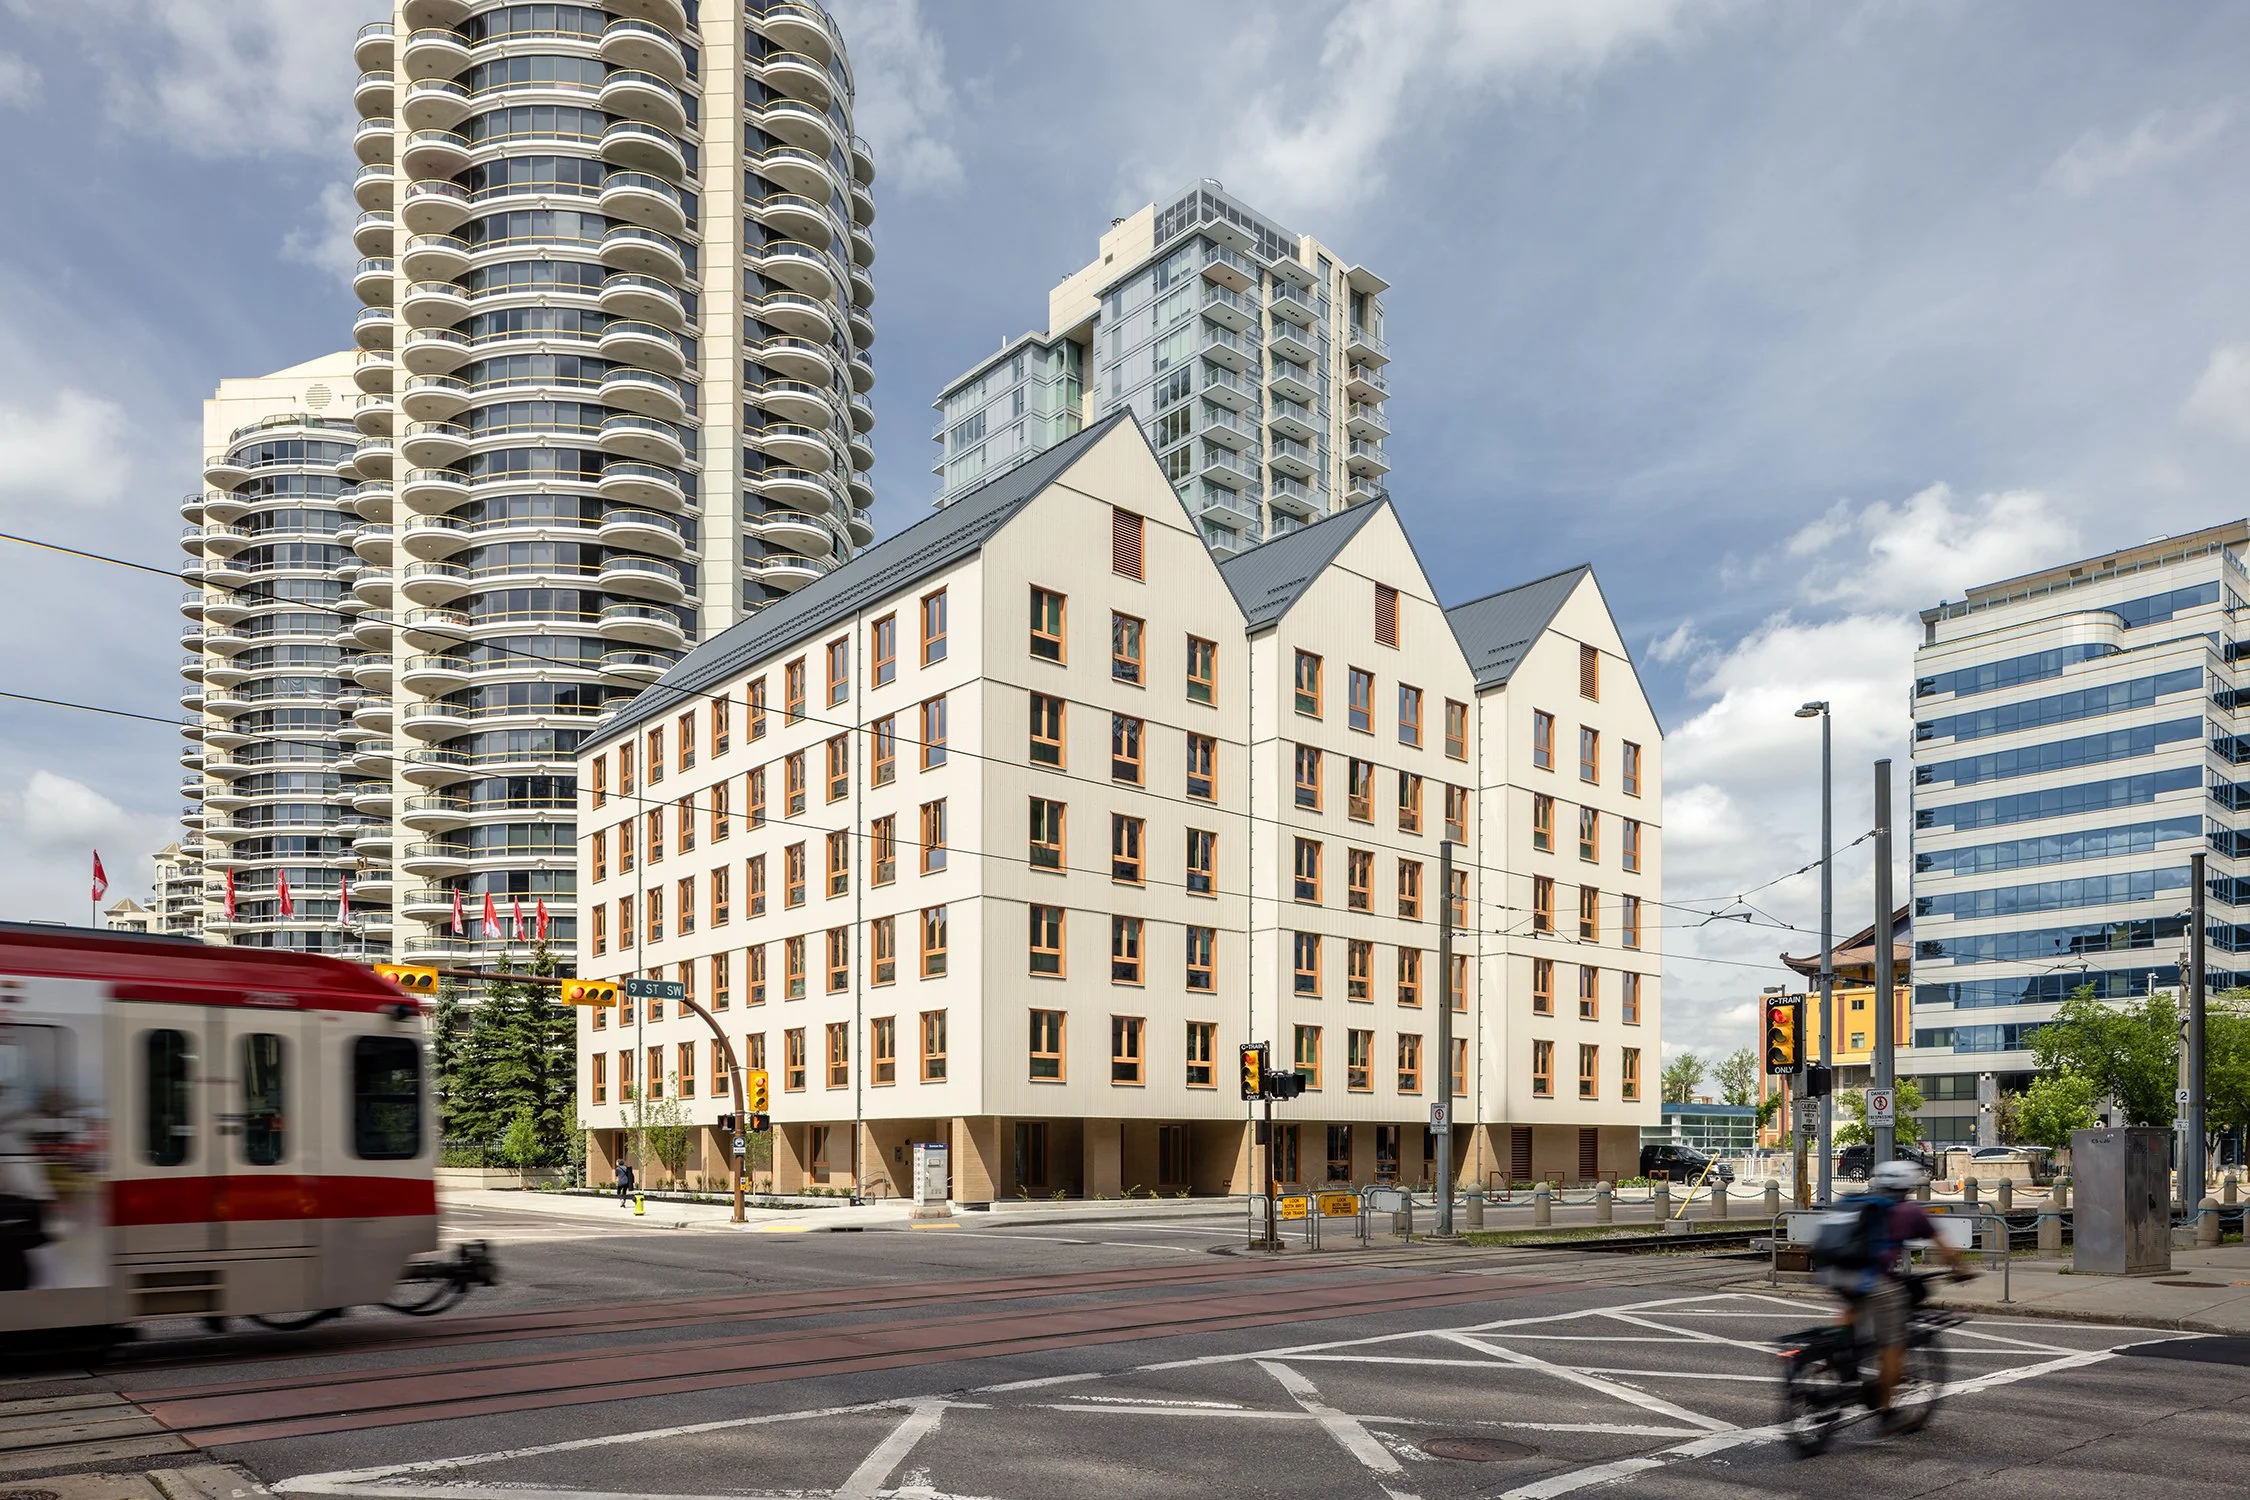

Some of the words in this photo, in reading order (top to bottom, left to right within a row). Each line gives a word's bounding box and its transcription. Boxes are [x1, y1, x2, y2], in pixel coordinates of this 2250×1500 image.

[630, 983, 637, 993] 9
[646, 984, 659, 994] ST
[667, 985, 682, 996] SW
[1768, 997, 1801, 1005] C-TRAIN
[2180, 1091, 2187, 1100] 2
